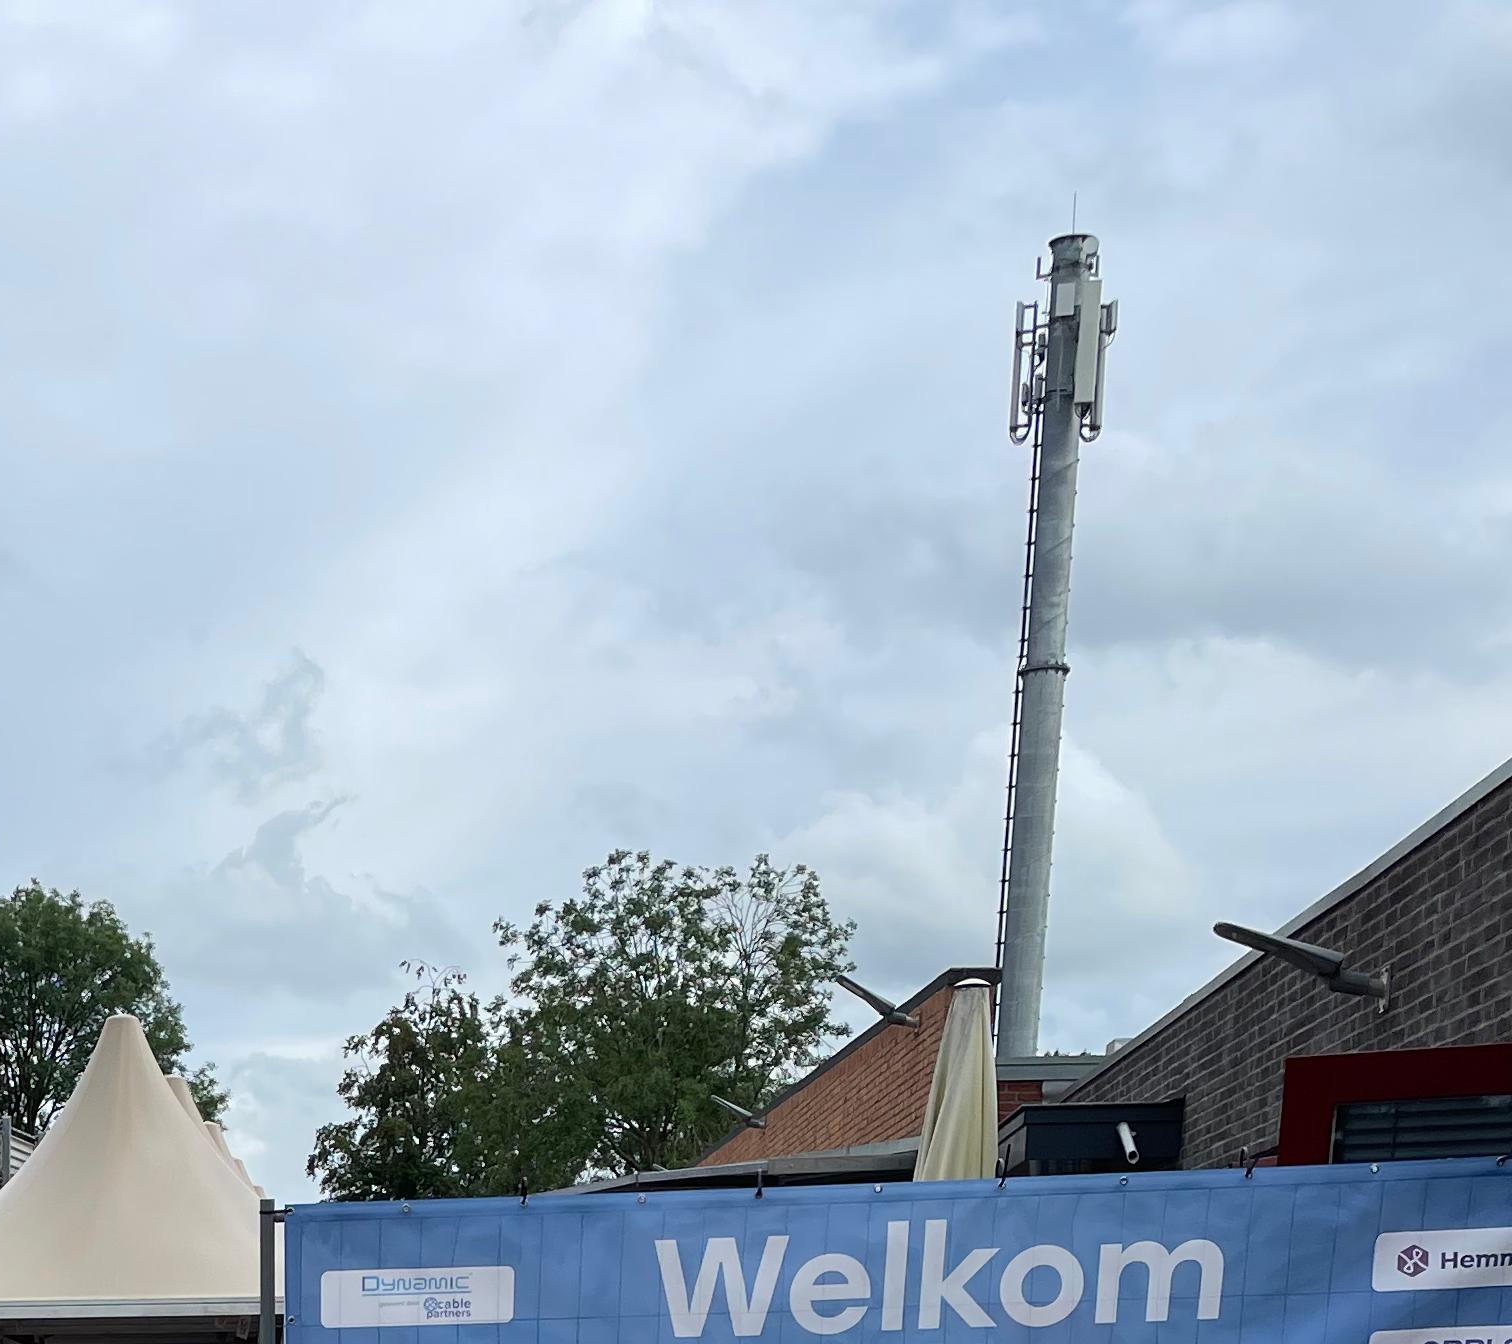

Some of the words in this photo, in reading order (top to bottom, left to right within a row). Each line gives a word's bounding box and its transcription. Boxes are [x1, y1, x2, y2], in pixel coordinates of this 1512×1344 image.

[1441, 1251, 1512, 1270] Hemm
[653, 1218, 1224, 1338] Welkom
[438, 1298, 472, 1309] cable
[426, 1309, 472, 1319] partners
